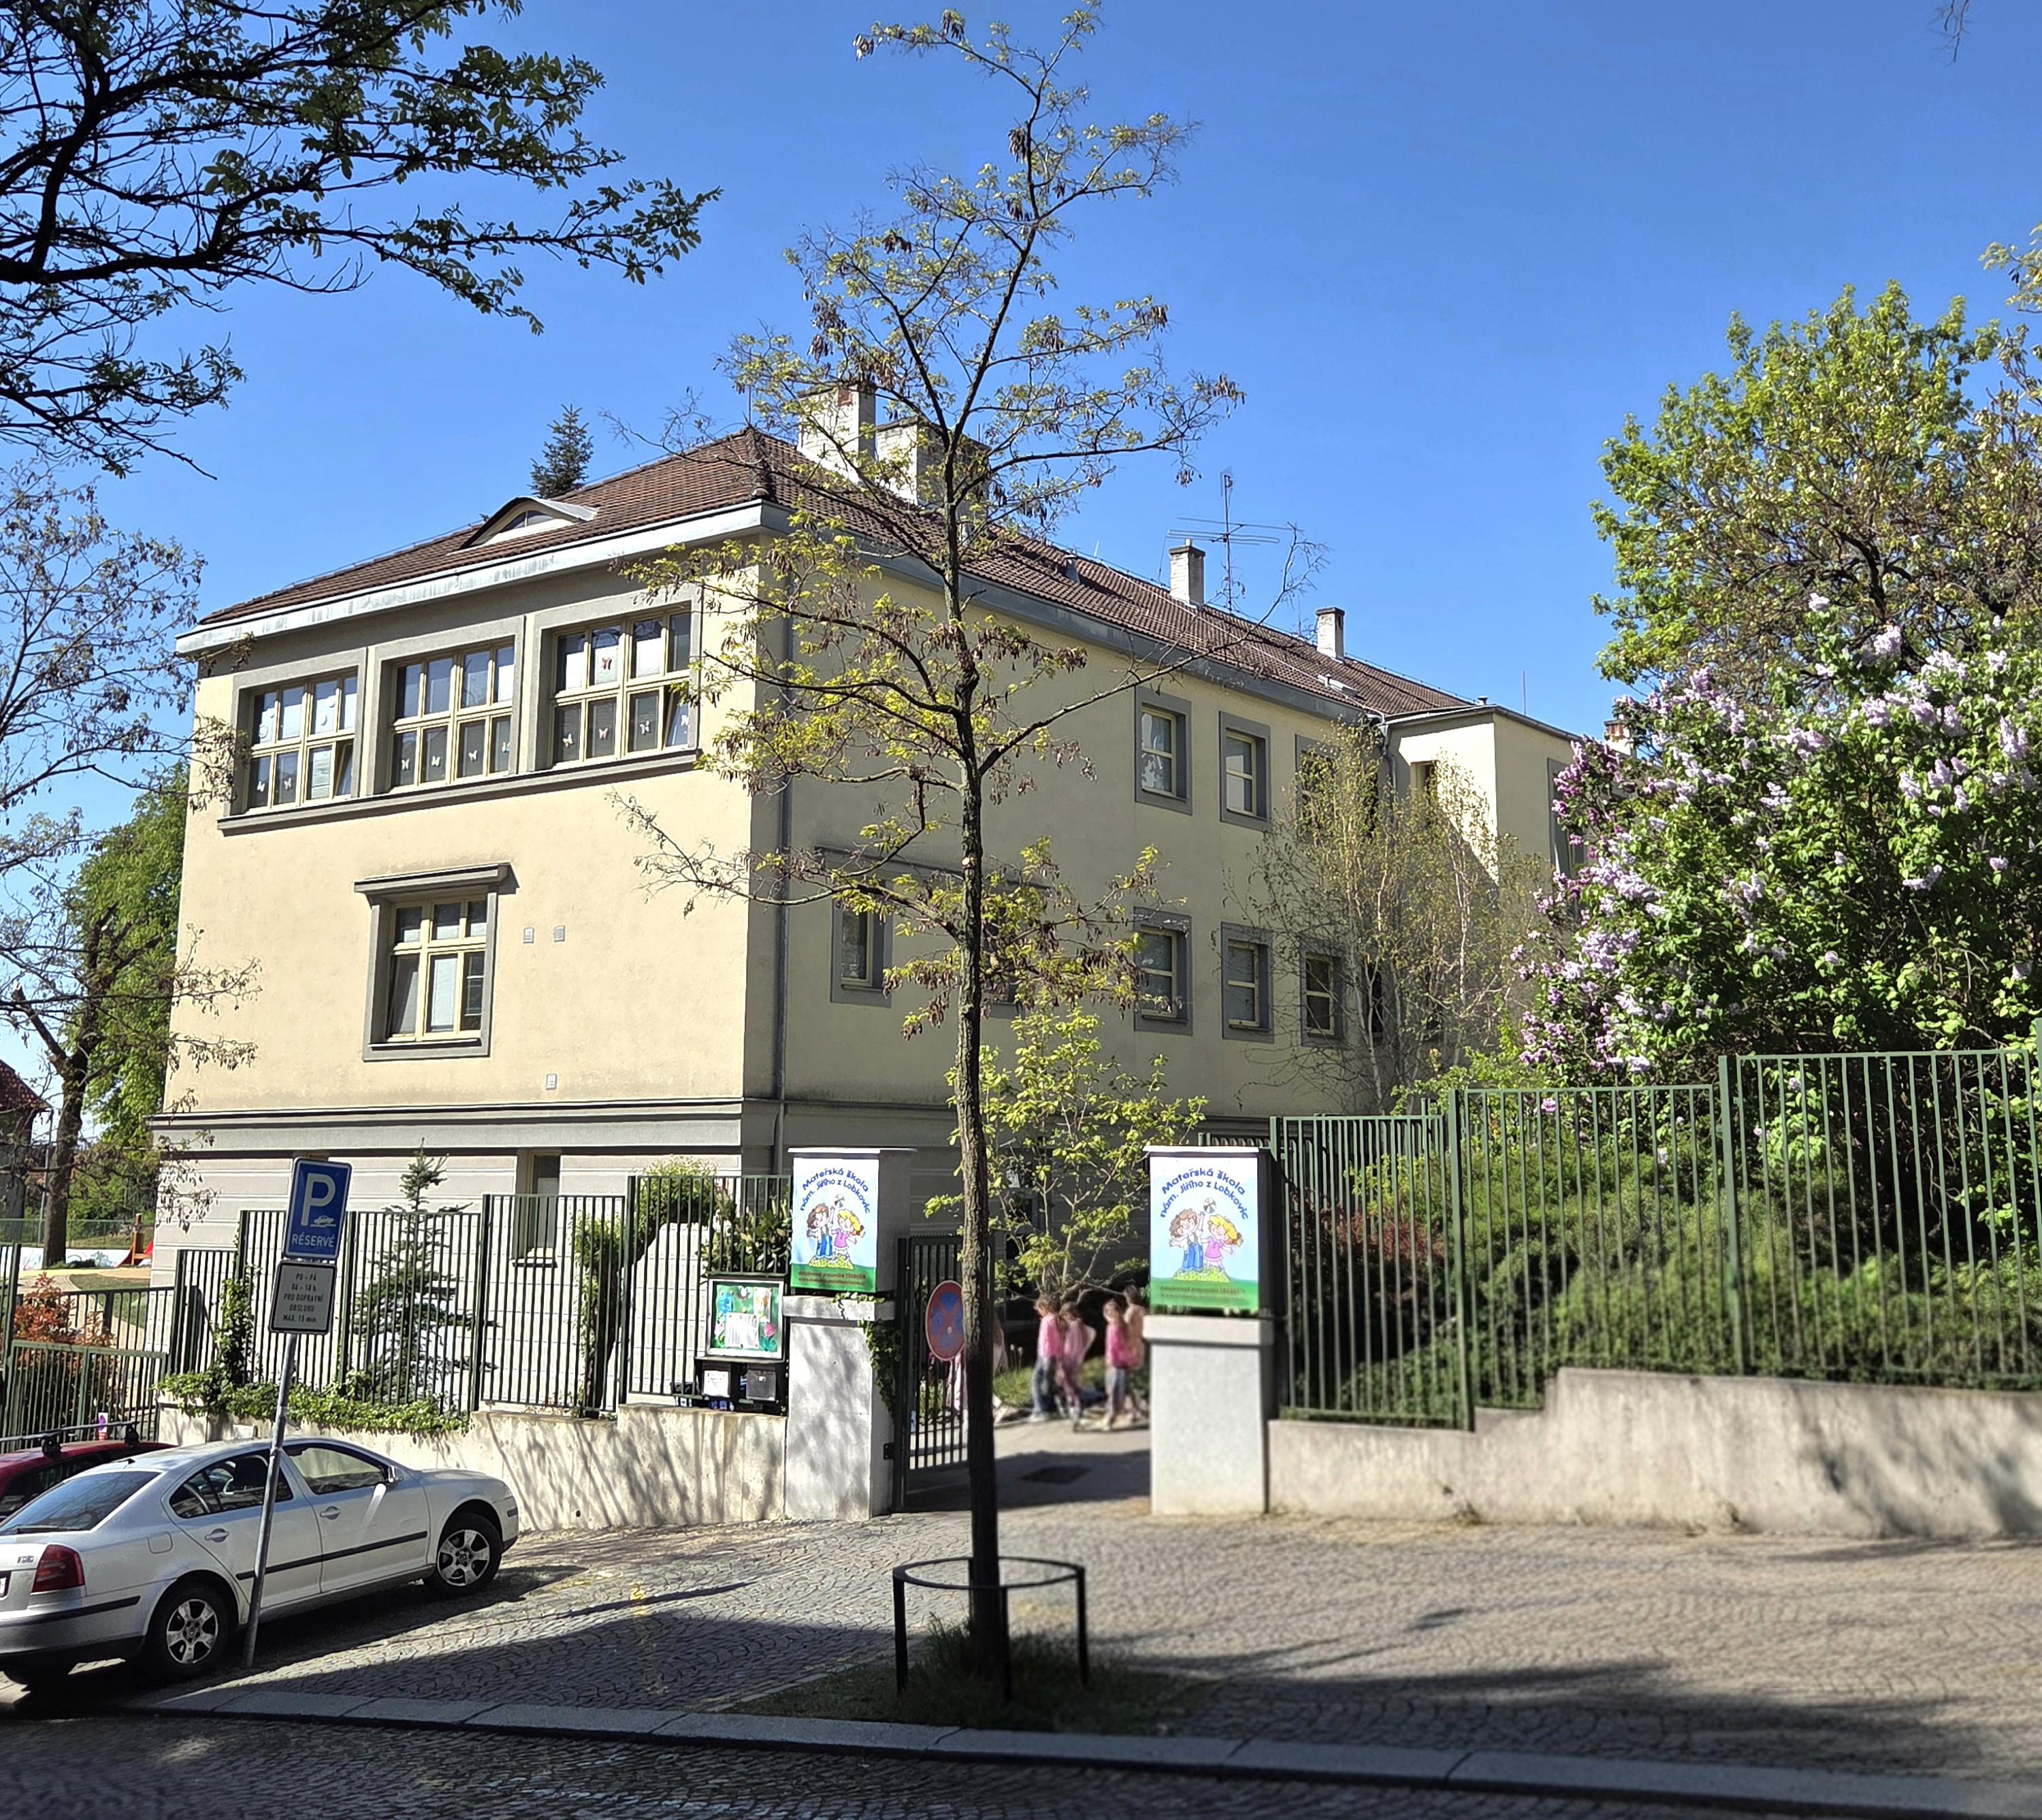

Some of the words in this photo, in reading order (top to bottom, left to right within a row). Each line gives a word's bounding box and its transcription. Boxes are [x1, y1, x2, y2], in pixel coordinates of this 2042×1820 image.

[803, 1167, 844, 1190] Mateřská
[846, 1170, 869, 1192] škola
[1162, 1168, 1214, 1194] Mateřská
[1216, 1170, 1245, 1195] škola
[301, 1173, 336, 1226] P
[800, 1190, 815, 1211] nám.
[817, 1178, 835, 1190] Jiřího
[843, 1180, 871, 1214] Lobkovic
[1160, 1194, 1179, 1218] nám.
[1180, 1180, 1203, 1194] Jiřího
[1214, 1181, 1248, 1220] Lobkovic
[291, 1231, 335, 1248] RÉSERVÉ
